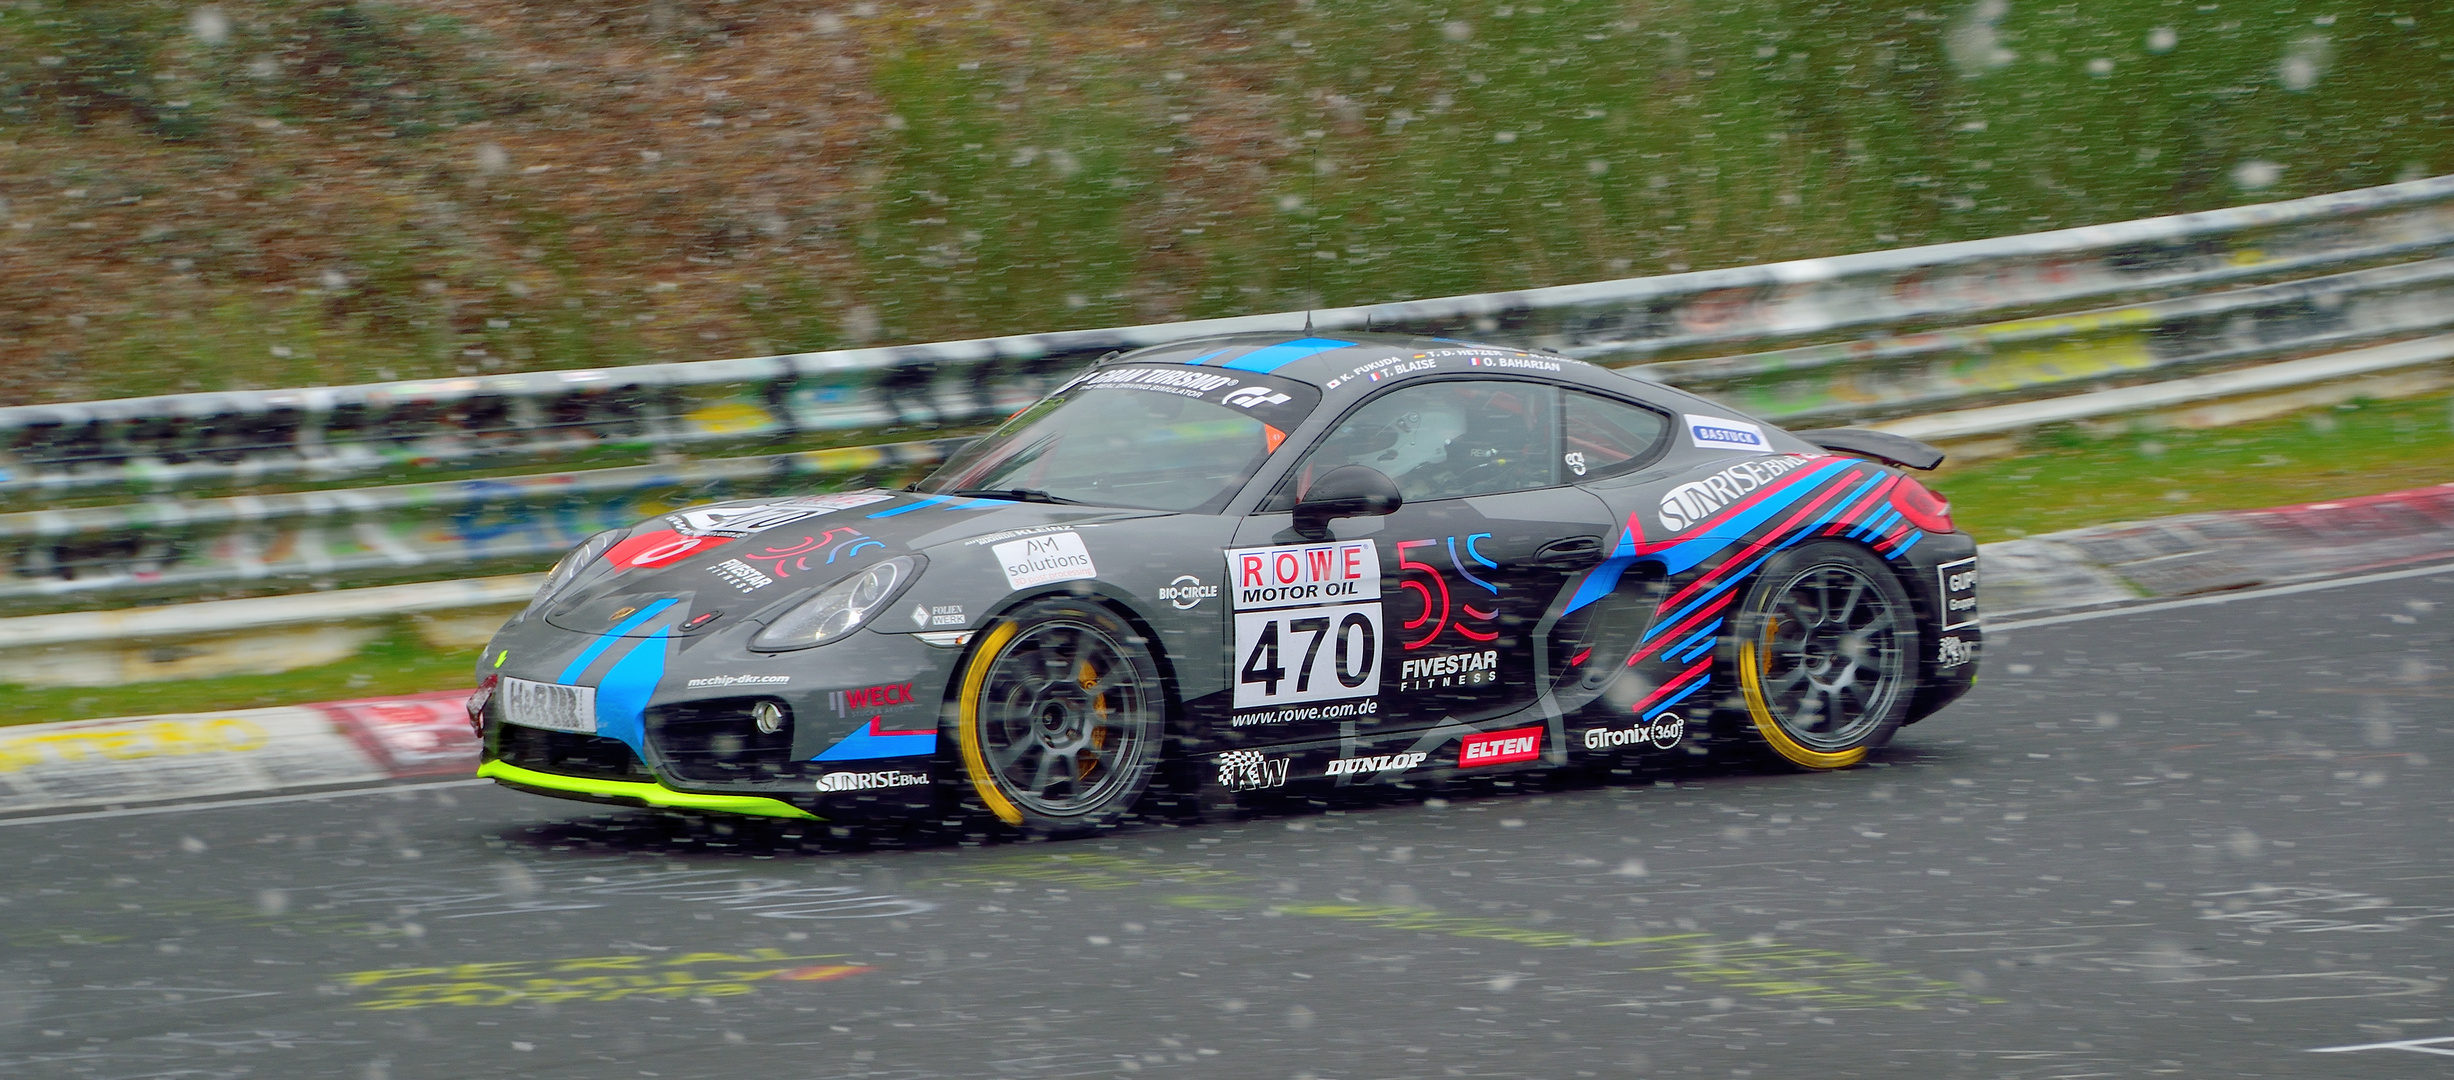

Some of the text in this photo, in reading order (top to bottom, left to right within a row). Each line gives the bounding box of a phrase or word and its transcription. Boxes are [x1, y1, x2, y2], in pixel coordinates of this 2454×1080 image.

[1340, 355, 1402, 384] K. FUKUDA
[1380, 358, 1437, 379] T. BLAISE
[1483, 357, 1497, 367] O.
[1499, 358, 1561, 372] BAHARIAN
[1088, 369, 1138, 385] GRAN
[1150, 384, 1205, 399] SIMULATOR
[1701, 427, 1755, 444] BASTUCK
[718, 557, 773, 590] FIVESTAR
[1008, 554, 1088, 577] solutions
[1014, 567, 1093, 587] 3D post processing
[1241, 546, 1362, 588] ROWE
[706, 565, 754, 594] FITNESS
[1159, 585, 1218, 600] BIO-CIRCLE
[1242, 581, 1359, 603] MOTOR OIL
[932, 605, 963, 616] FOLIEN
[933, 614, 965, 625] WERK
[1241, 611, 1376, 698] 470
[1401, 650, 1498, 680] FIVESTAR
[687, 674, 791, 687] mcchip-dkr.com
[1400, 671, 1497, 692] FITNESS
[846, 682, 915, 709] WECK
[1232, 699, 1378, 728] www.rowe.com.de
[1466, 736, 1534, 759] ELTEN
[1584, 723, 1651, 750] GTronix
[1230, 757, 1290, 793] KW
[1324, 752, 1427, 777] DUNLOP
